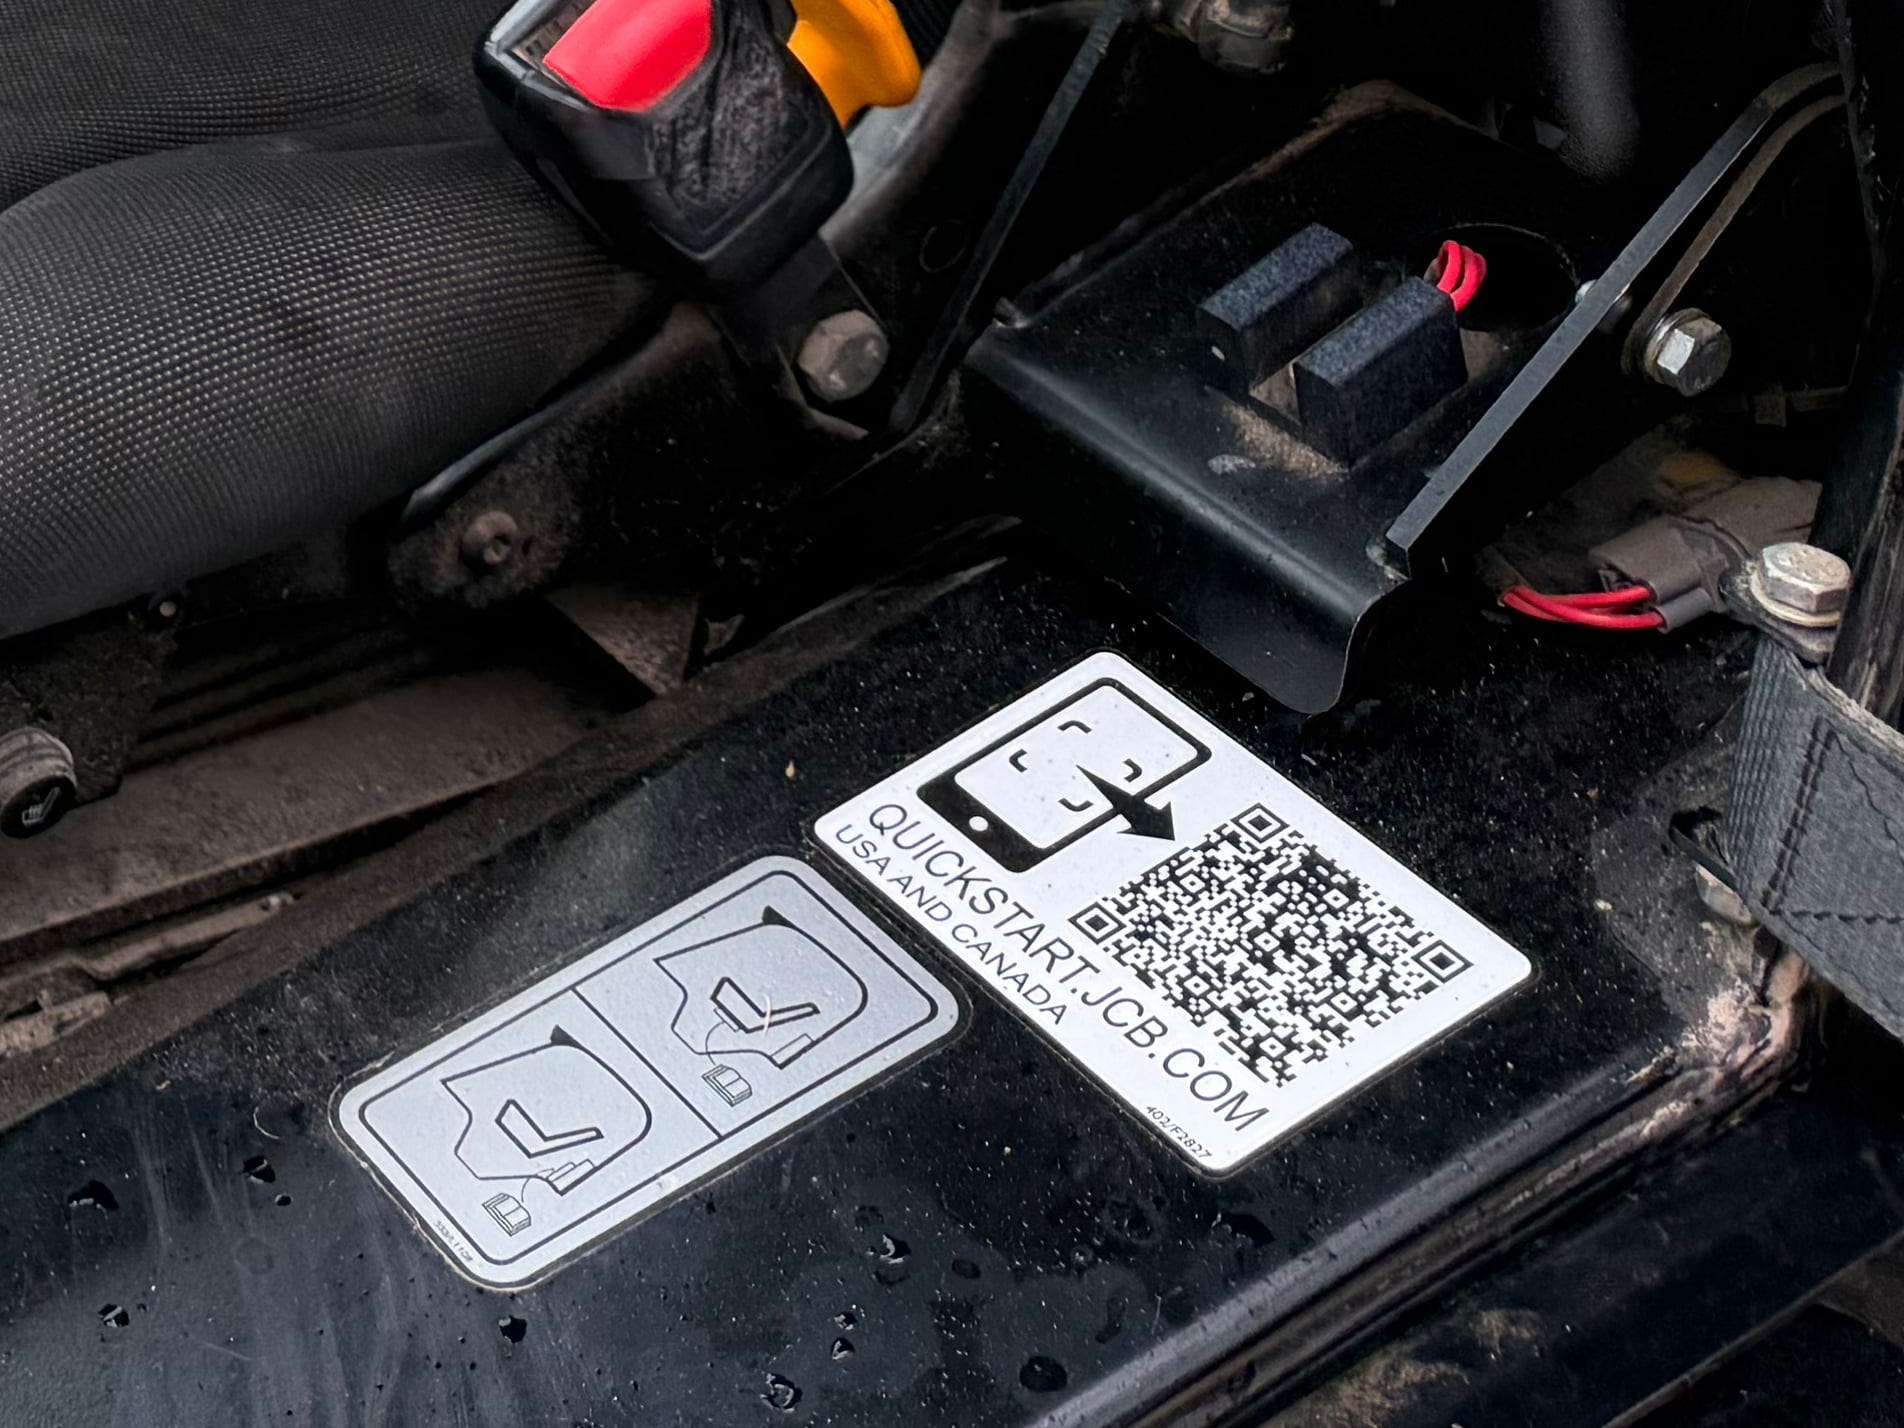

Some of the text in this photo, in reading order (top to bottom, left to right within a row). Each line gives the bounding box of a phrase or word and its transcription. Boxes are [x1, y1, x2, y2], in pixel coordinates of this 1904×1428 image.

[835, 823, 1068, 1025] USA AND CANADA
[868, 803, 1270, 1132] QUICKSTART.JCB.COM
[1146, 1106, 1213, 1158] 402/F2827
